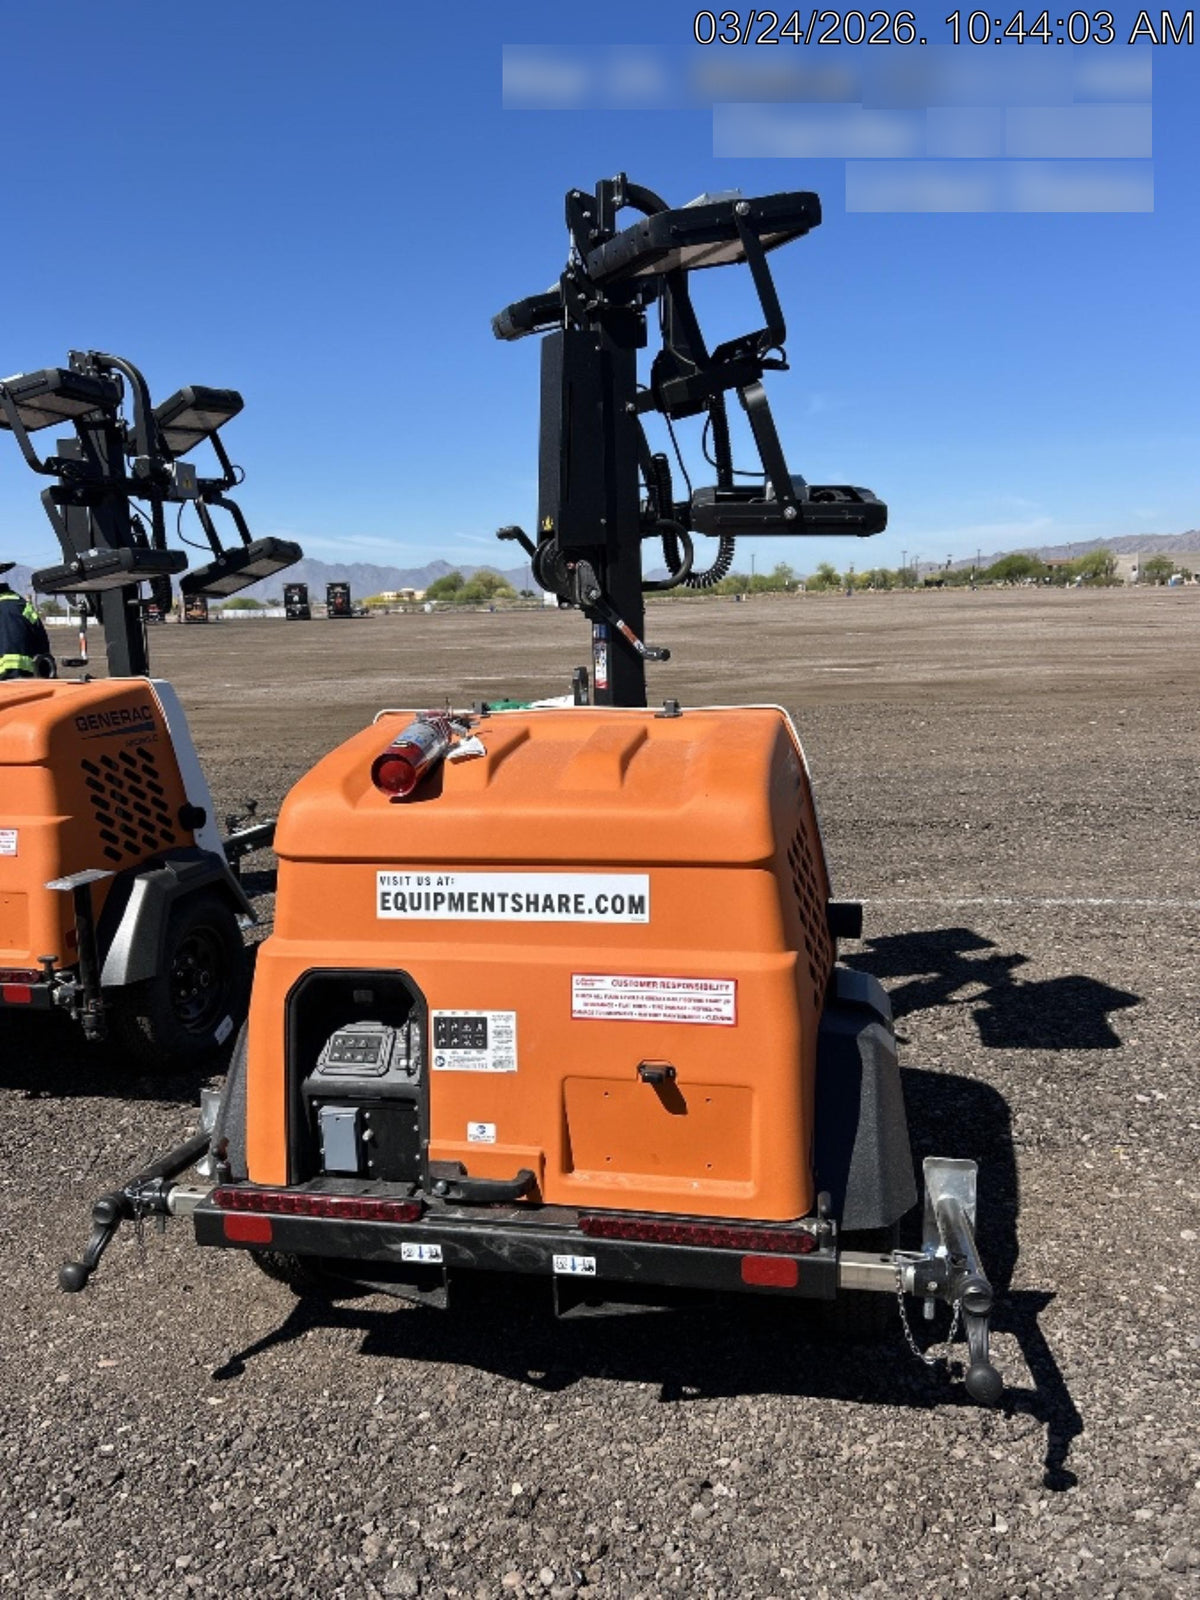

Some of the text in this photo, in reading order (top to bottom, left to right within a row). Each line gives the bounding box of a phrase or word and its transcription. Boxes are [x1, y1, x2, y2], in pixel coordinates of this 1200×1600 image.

[75, 705, 153, 731] GENERAC
[379, 876, 455, 886] VISIT US AT:
[380, 891, 646, 915] EQUIPMENTSHARE.COM
[611, 978, 659, 990] CUSTOMER
